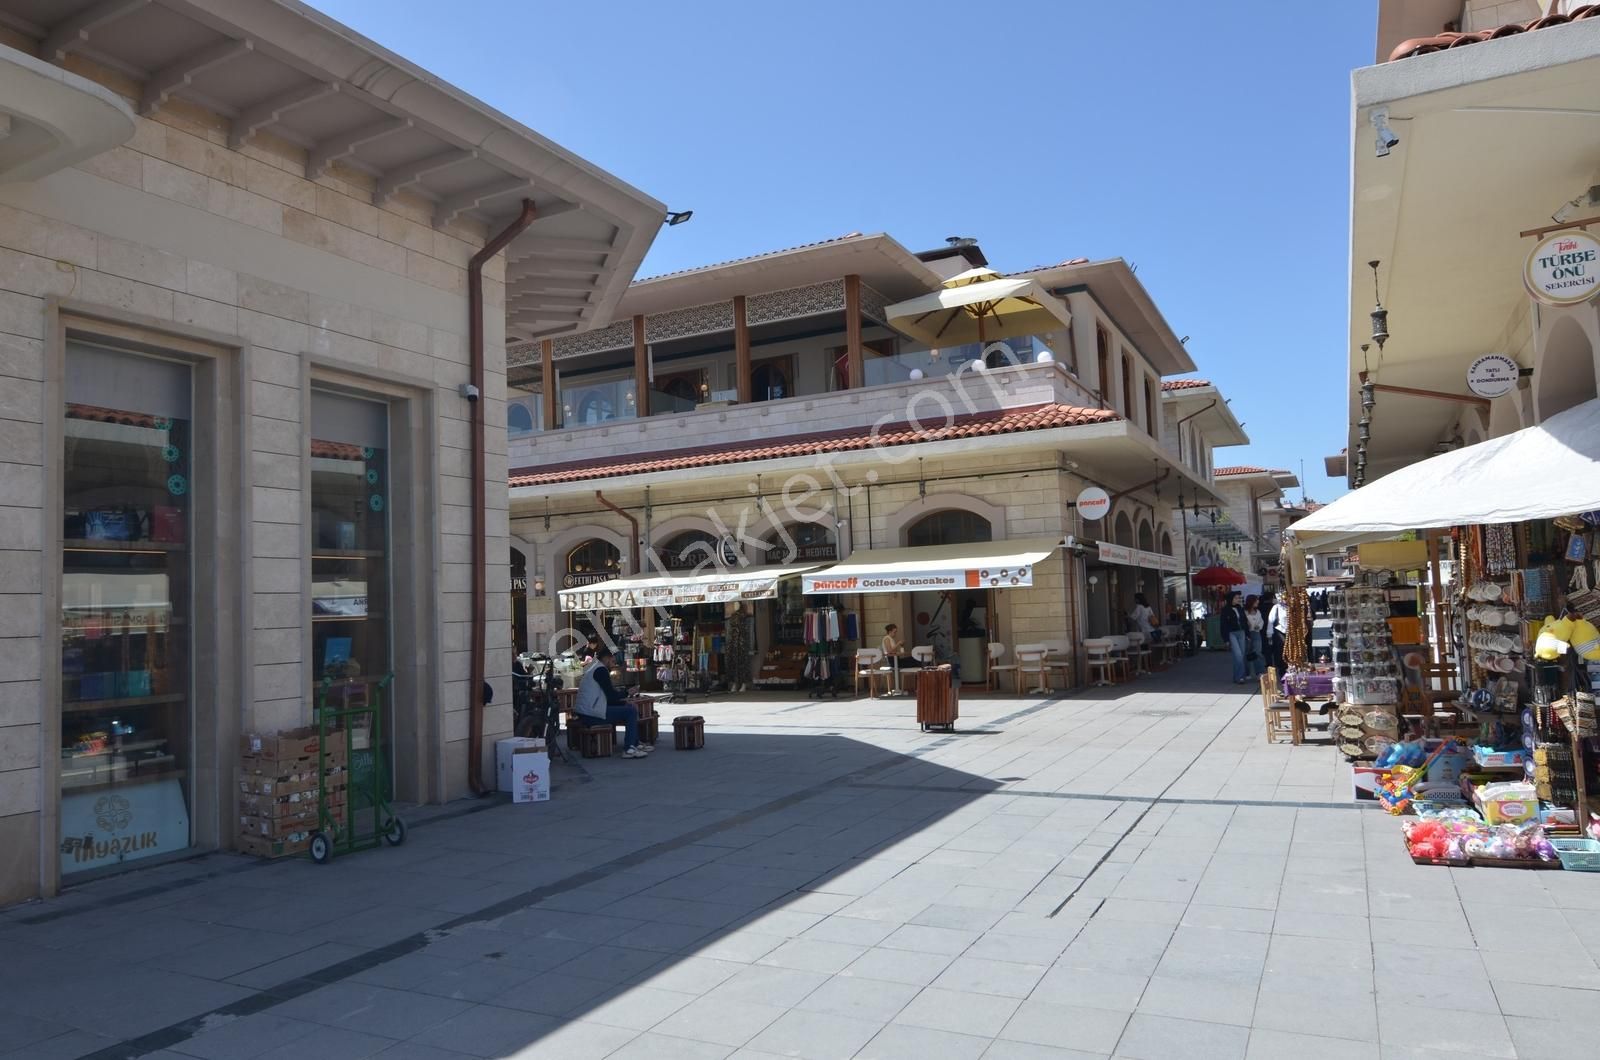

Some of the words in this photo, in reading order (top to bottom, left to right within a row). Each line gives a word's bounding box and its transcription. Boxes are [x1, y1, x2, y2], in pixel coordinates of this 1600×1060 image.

[1538, 250, 1596, 268] TÜRBE
[1552, 264, 1585, 280] ÖNÜ
[1079, 498, 1106, 508] pancoff
[670, 552, 710, 567] BERR
[813, 577, 858, 592] pancoff
[565, 590, 638, 610] BERRA
